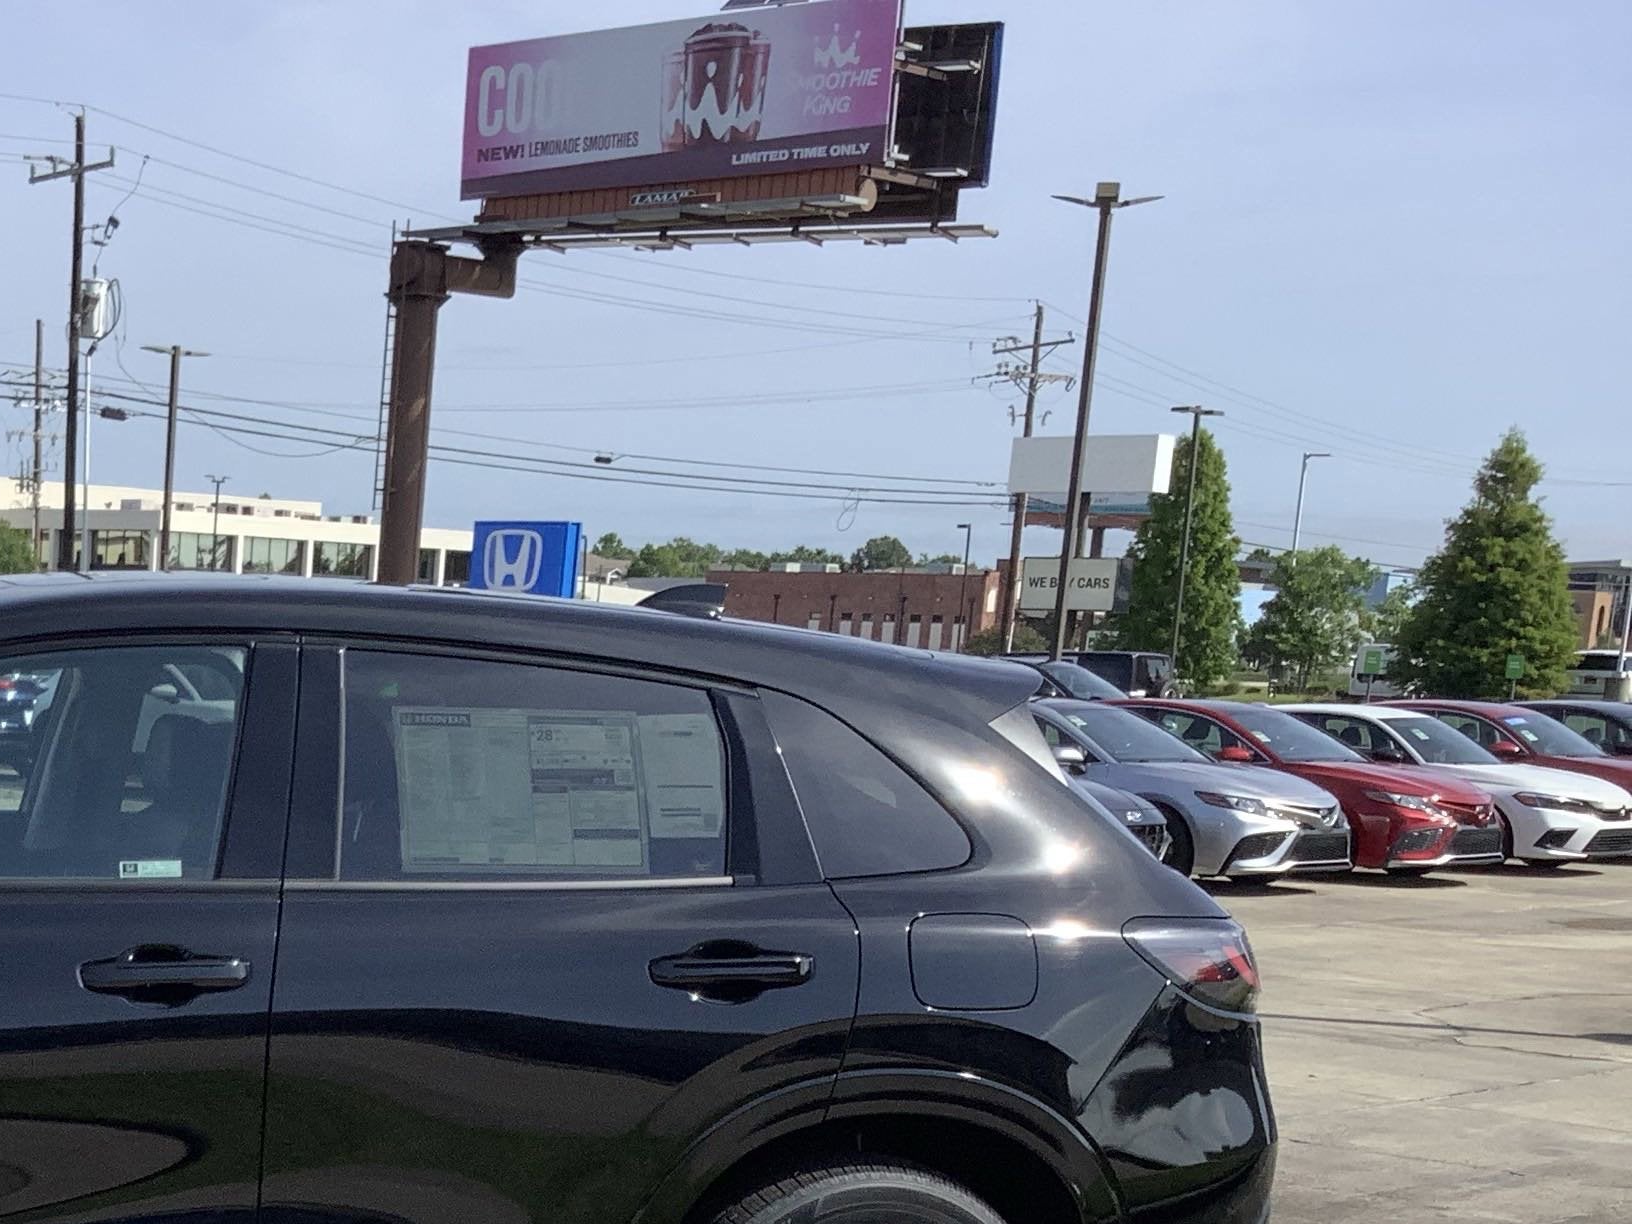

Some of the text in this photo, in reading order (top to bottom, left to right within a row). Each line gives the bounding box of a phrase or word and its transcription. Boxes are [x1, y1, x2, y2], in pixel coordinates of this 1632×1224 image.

[802, 94, 852, 118] KING
[477, 130, 640, 163] NEW! LEMONADE SMOOTHIES
[731, 142, 871, 166] LIMITED TIME ONLY
[1028, 576, 1110, 589] WE BY CARS
[418, 713, 468, 726] HONDA
[536, 729, 553, 742] 28
